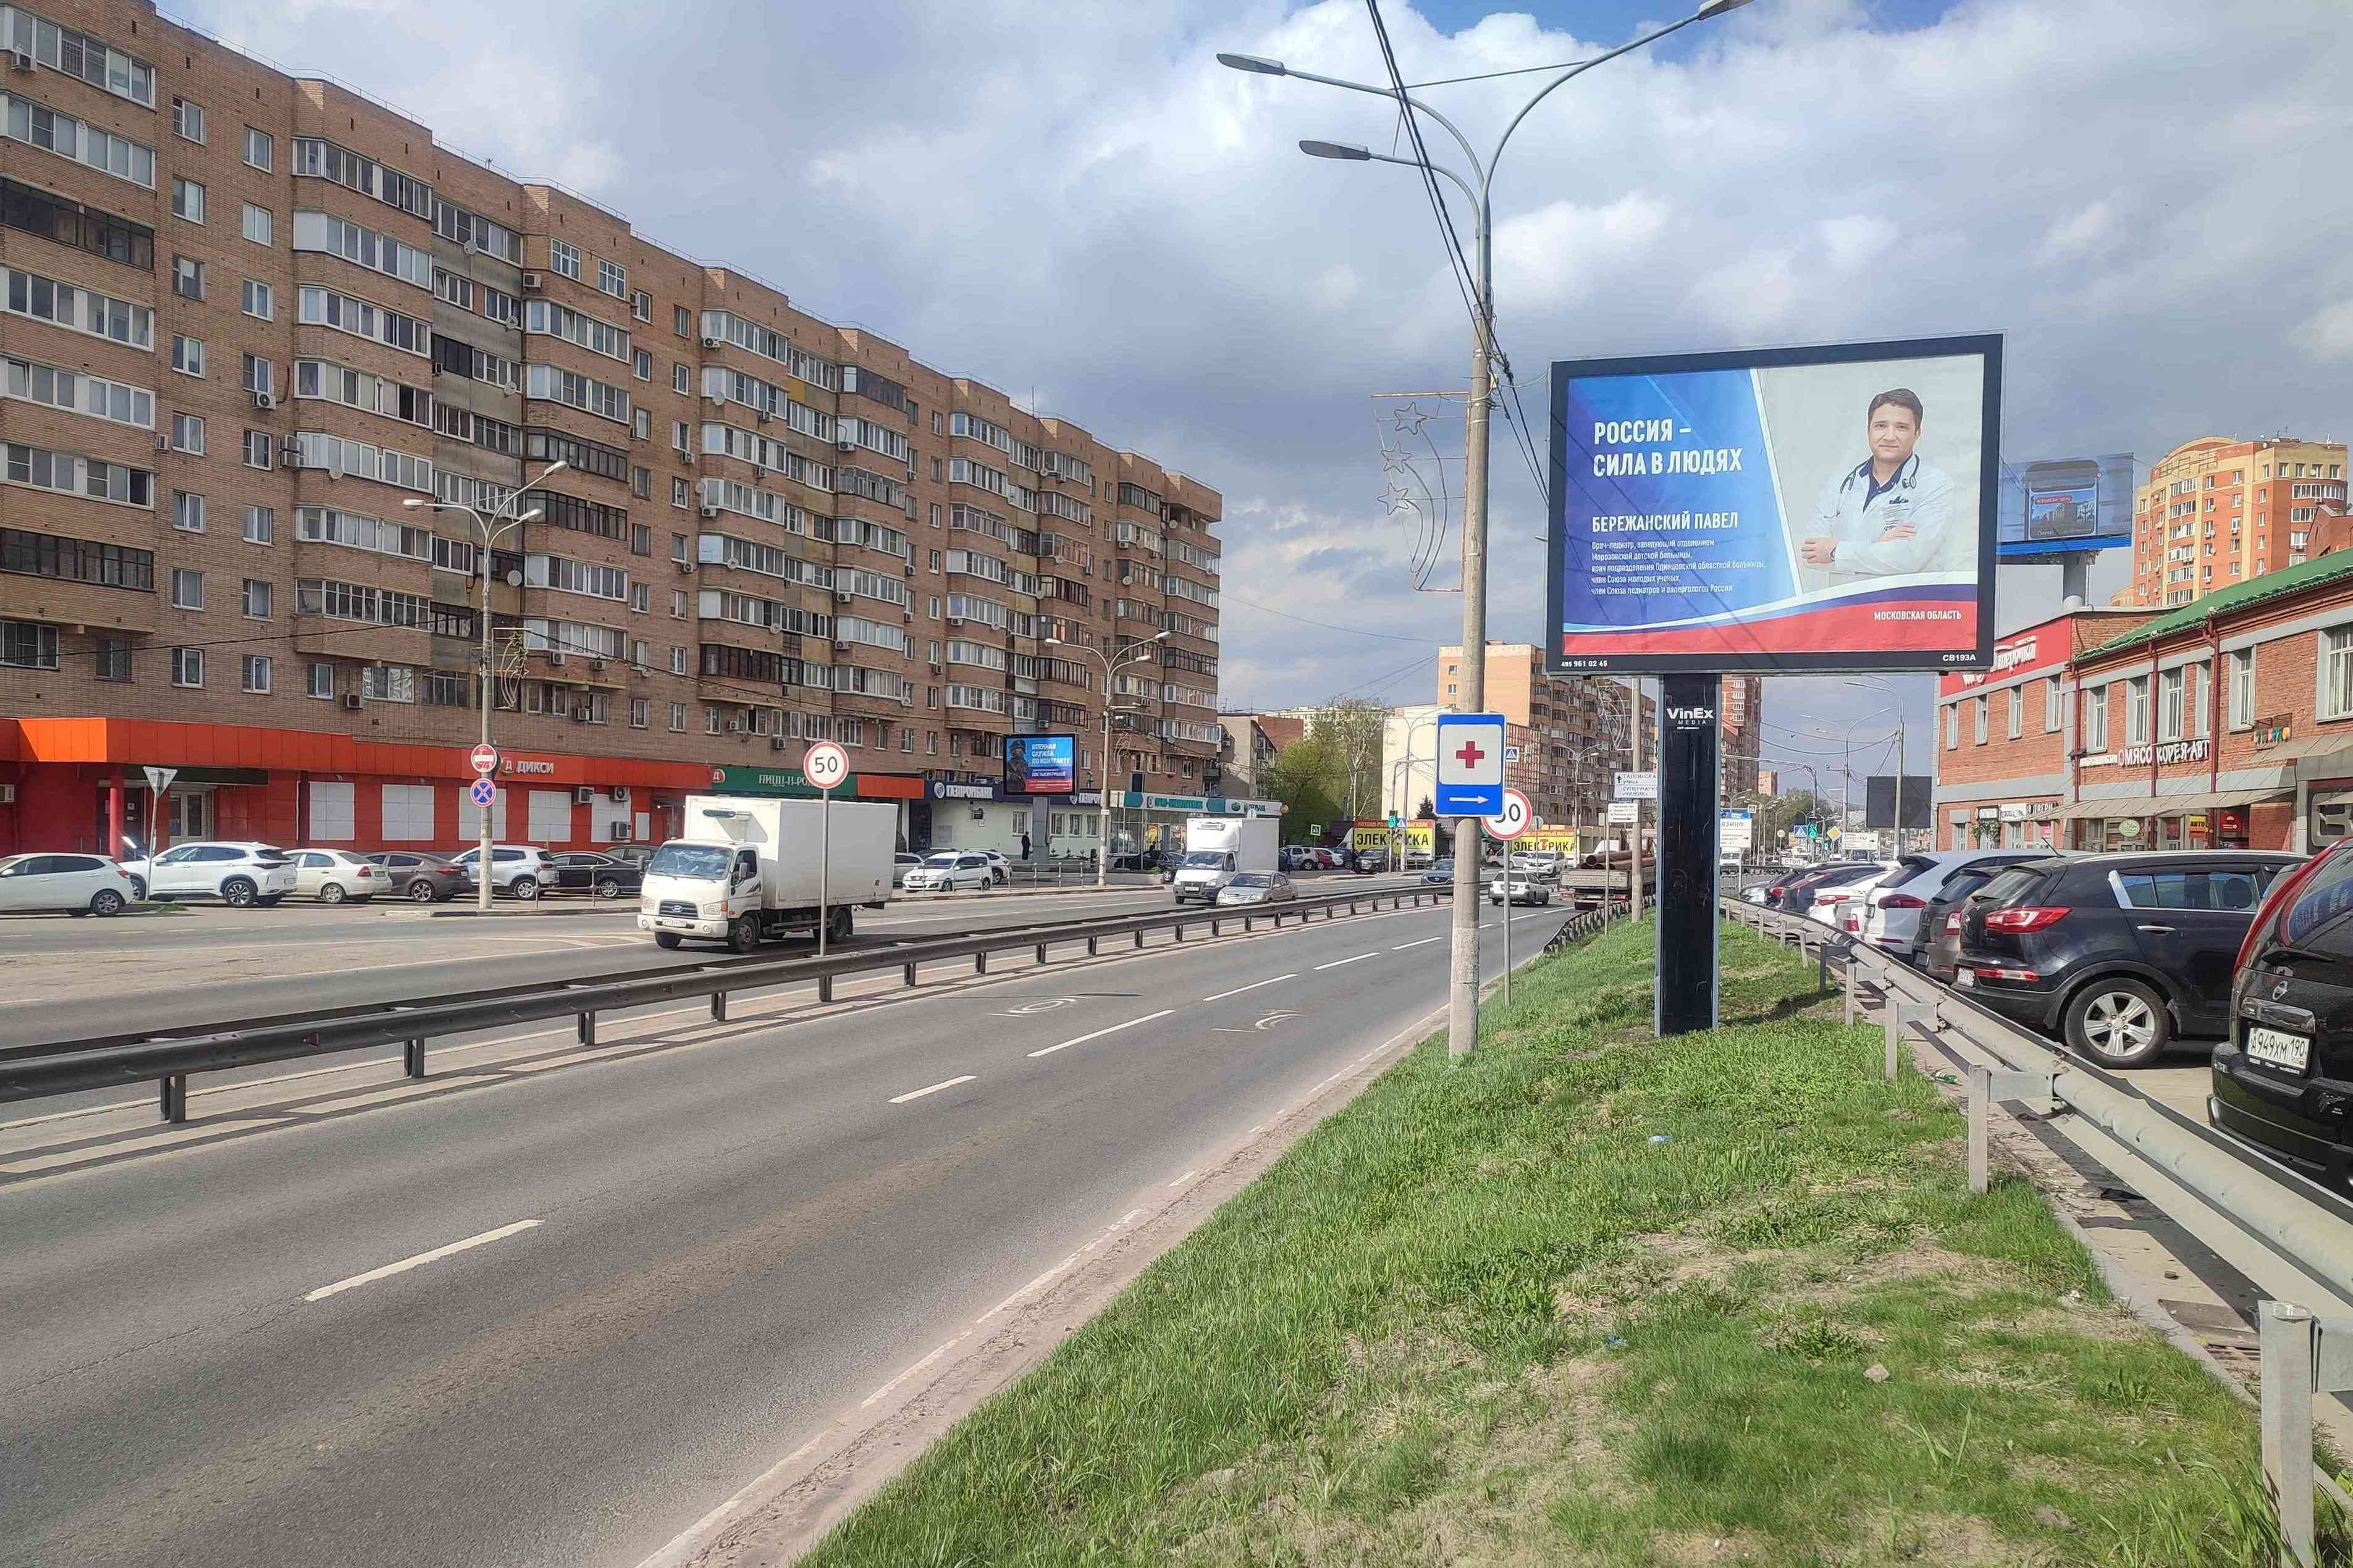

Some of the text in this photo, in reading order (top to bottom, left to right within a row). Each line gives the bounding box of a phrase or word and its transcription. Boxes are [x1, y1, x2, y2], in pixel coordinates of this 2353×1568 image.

[1594, 419, 1673, 445] РОССИЯ
[1593, 448, 1743, 477] СИЛА В ЛЮДЯХ
[1592, 509, 1739, 532] БЕРЕЖАНСКИЙ ПАВЕЛ
[1874, 610, 1962, 621] МОСКОВСКАЯ ОБЛАСТЬ
[1667, 707, 1714, 719] VinEx
[815, 756, 838, 773] 50
[2125, 745, 2152, 766] МЯСО
[516, 760, 554, 774] ДИКСИ
[1357, 833, 1429, 845] ЭЛЕККА
[2290, 1038, 2305, 1057] 190
